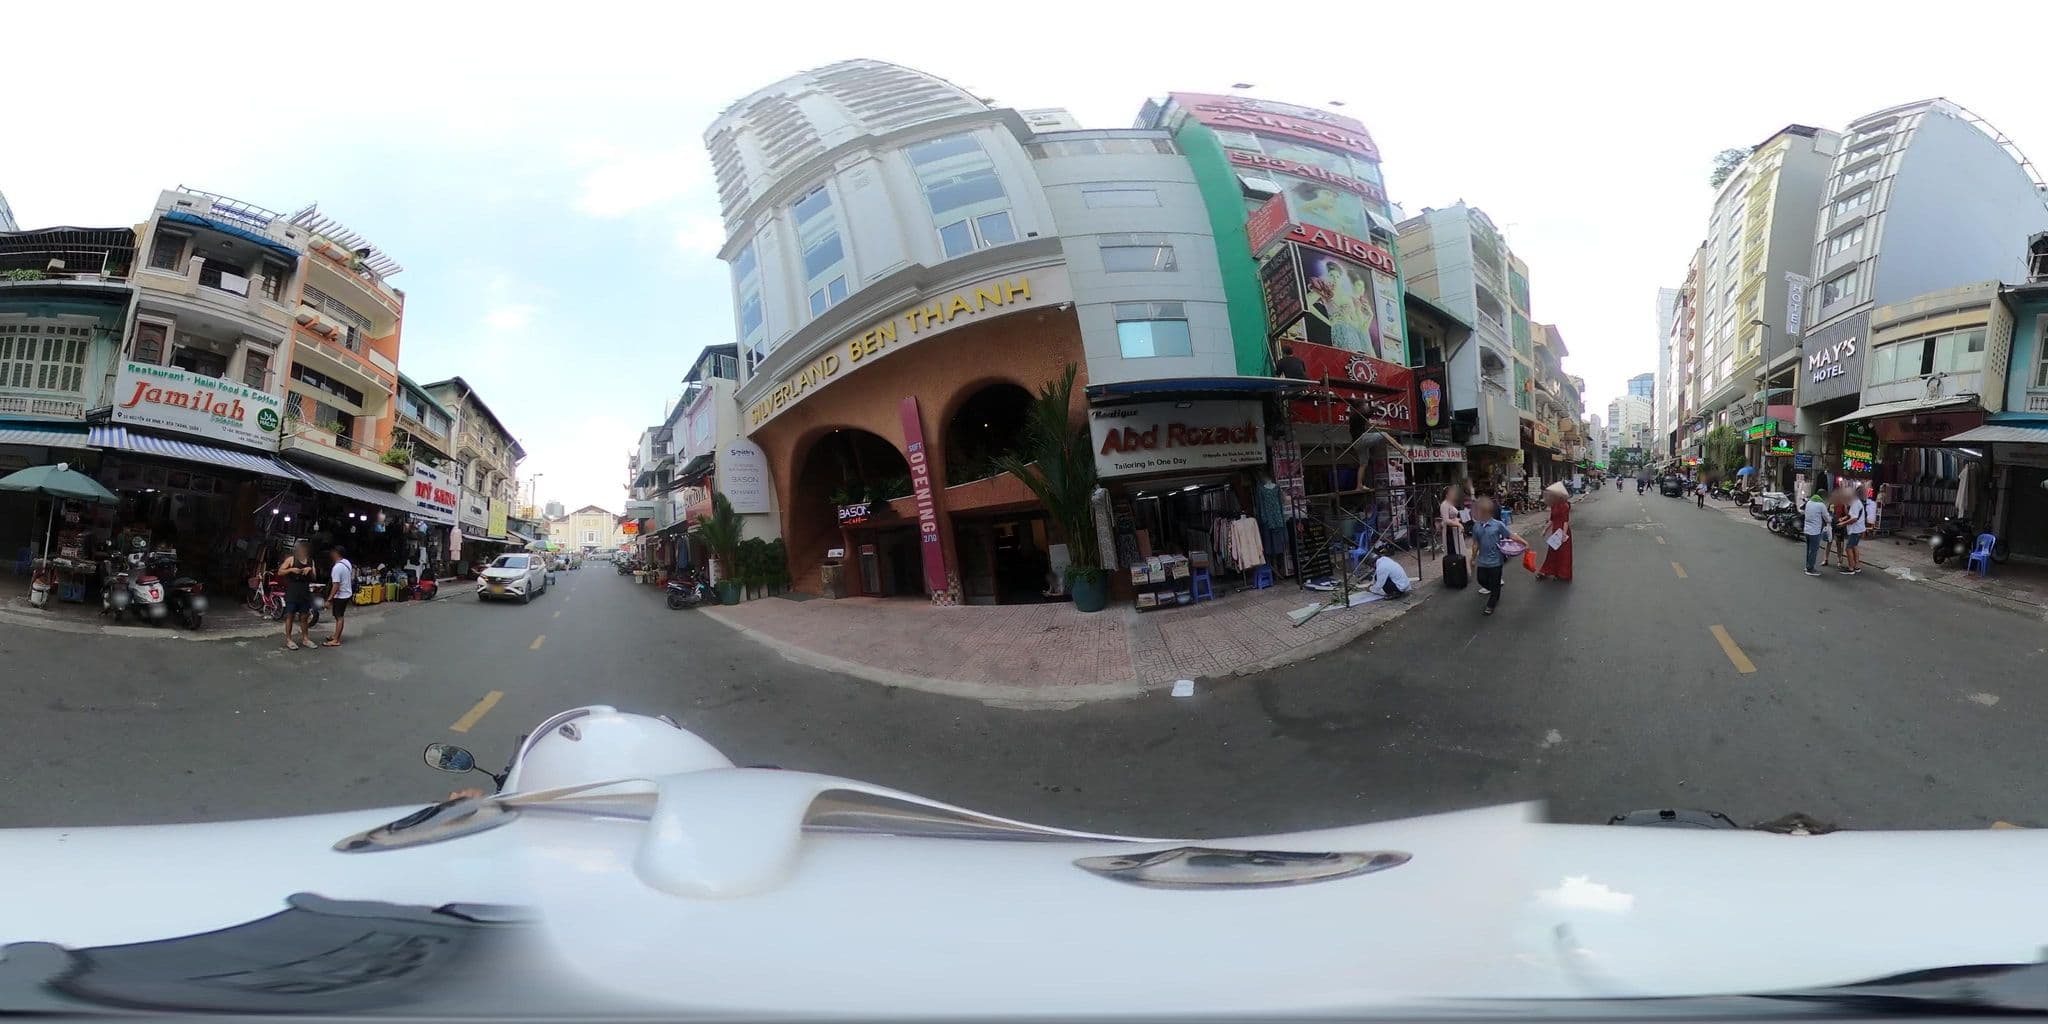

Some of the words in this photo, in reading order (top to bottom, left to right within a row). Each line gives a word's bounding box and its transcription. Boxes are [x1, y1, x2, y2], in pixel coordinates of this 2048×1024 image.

[1294, 164, 1386, 201] Alison
[1310, 229, 1397, 274] Alison
[1790, 283, 1802, 334] HOTEL
[751, 353, 840, 425] SILVERLAND
[848, 320, 898, 363] BEN
[906, 277, 1032, 334] THANH
[1808, 336, 1857, 371] MAY'S
[128, 363, 185, 382] Restaurant
[218, 380, 240, 395] Food
[242, 389, 249, 398] &
[1813, 364, 1845, 383] HOTEL
[119, 380, 246, 422] Jamilah
[908, 442, 923, 452] SOFT
[1101, 424, 1160, 456] Abd
[1166, 420, 1259, 449] Rozack
[1114, 462, 1146, 471] Tailoring
[1157, 458, 1171, 466] One
[1173, 457, 1188, 465] Day
[909, 452, 937, 533] OPENING
[839, 505, 870, 519] BASON
